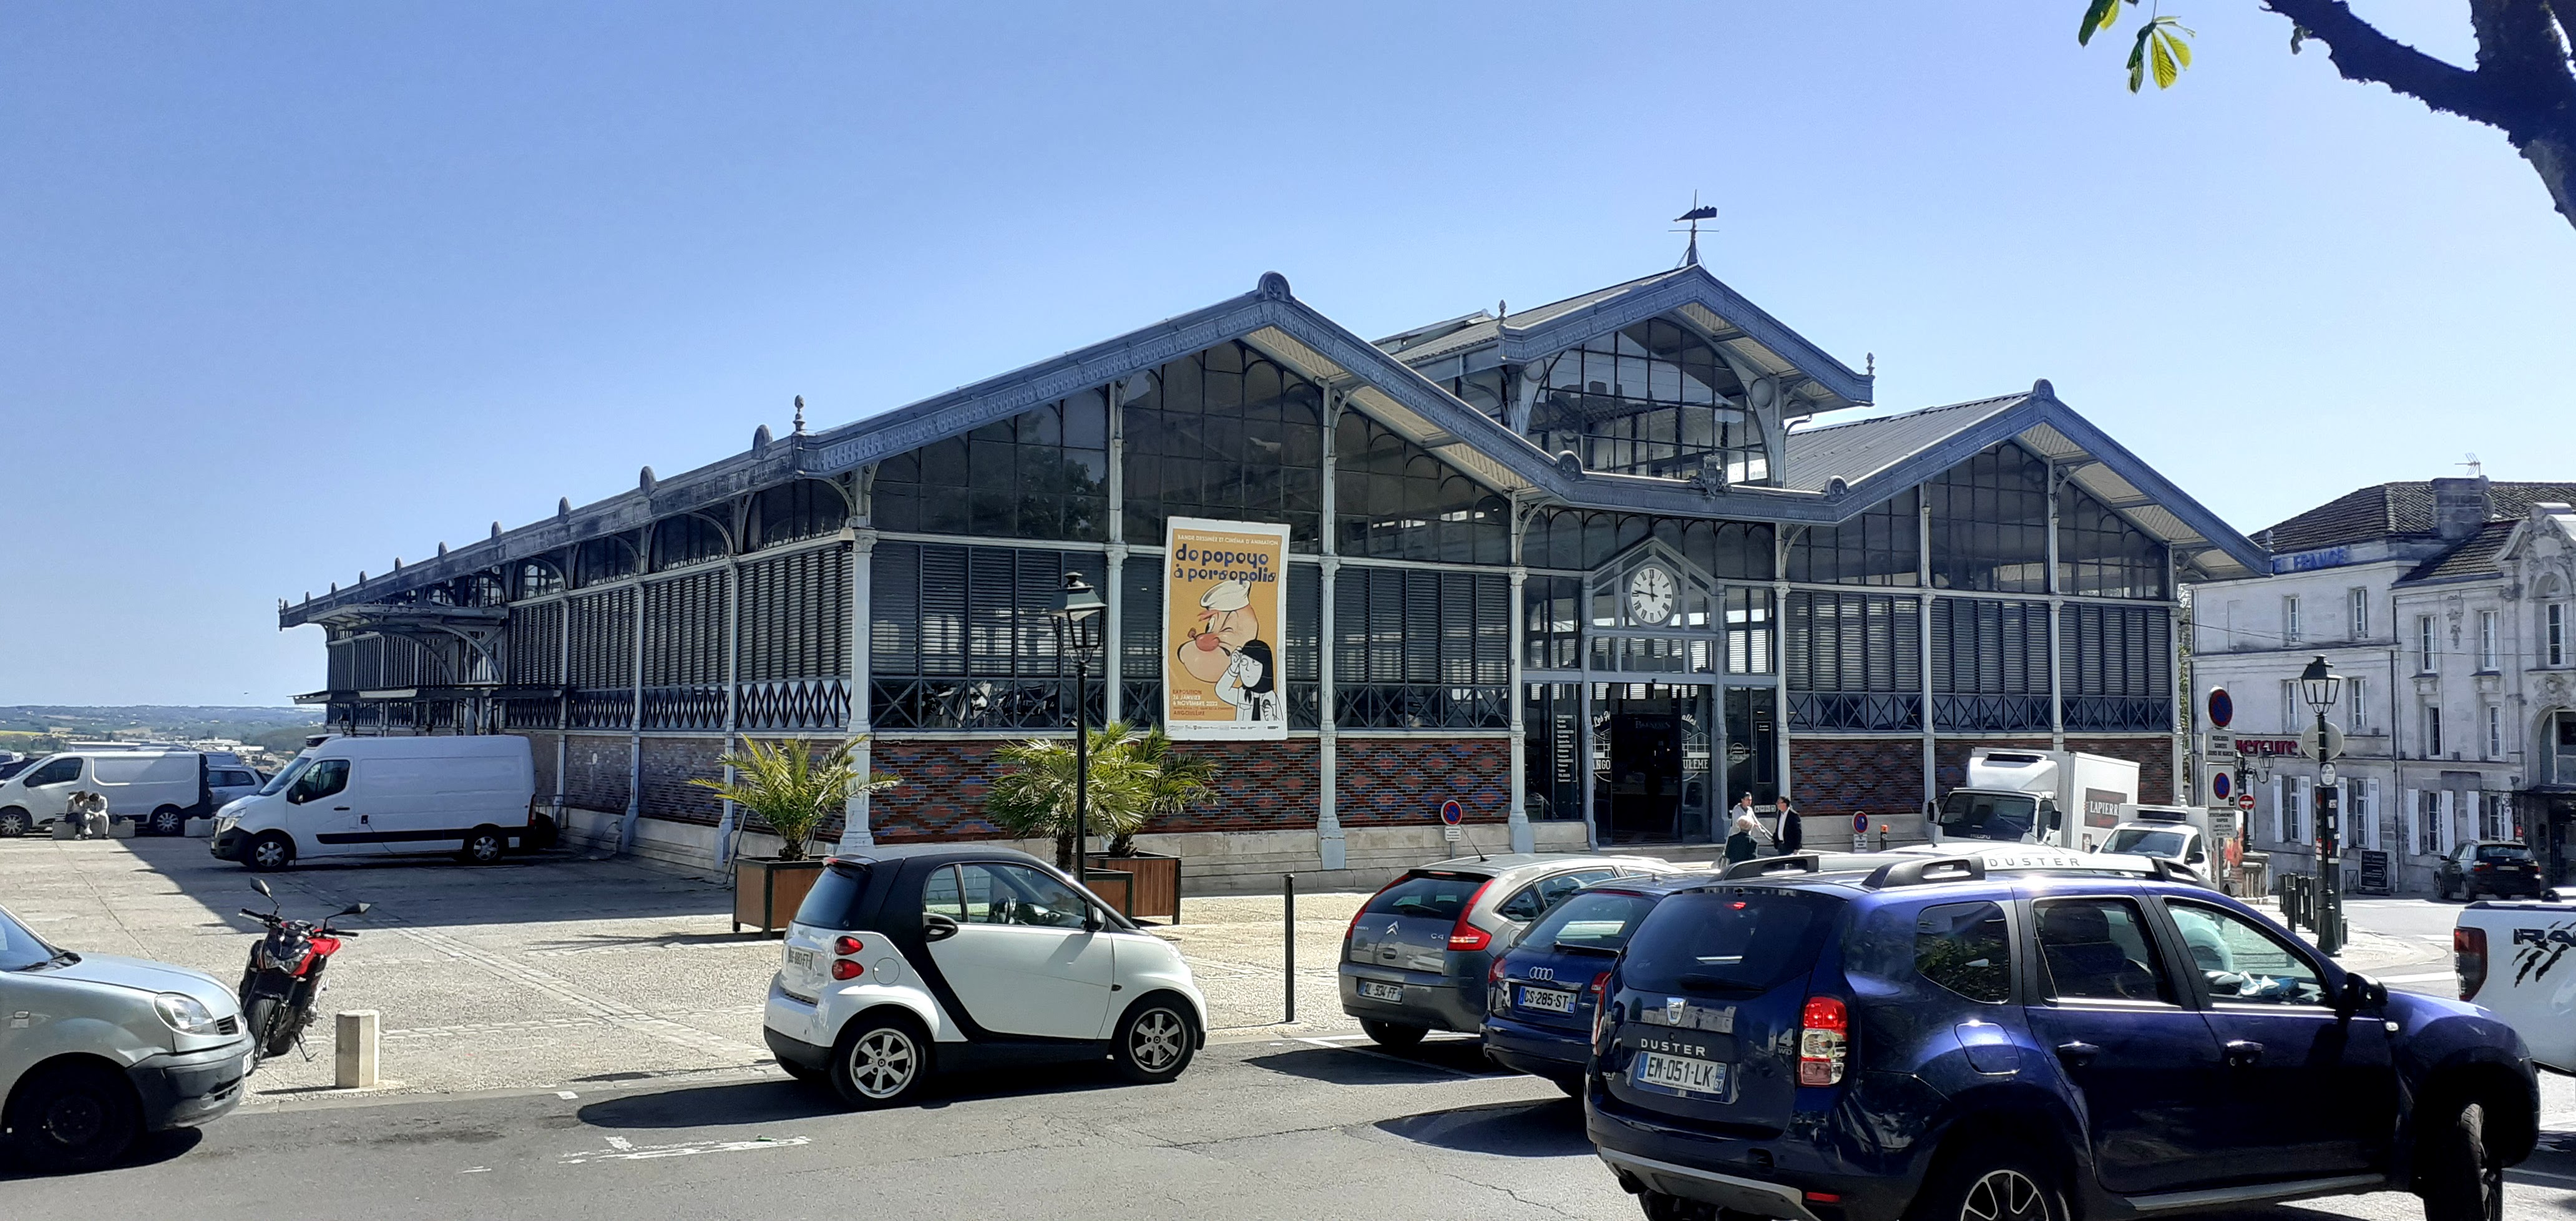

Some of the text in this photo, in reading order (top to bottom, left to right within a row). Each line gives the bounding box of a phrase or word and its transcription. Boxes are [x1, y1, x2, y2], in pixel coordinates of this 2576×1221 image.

[2293, 548, 2346, 570] FRANCE
[1593, 716, 1604, 728] Les
[2090, 800, 2119, 816] LAPIERR
[1988, 858, 2080, 867] DUSTER
[1430, 933, 1445, 941] C4
[1641, 1038, 1705, 1057] DUSTER
[1714, 1077, 1724, 1089] 67
